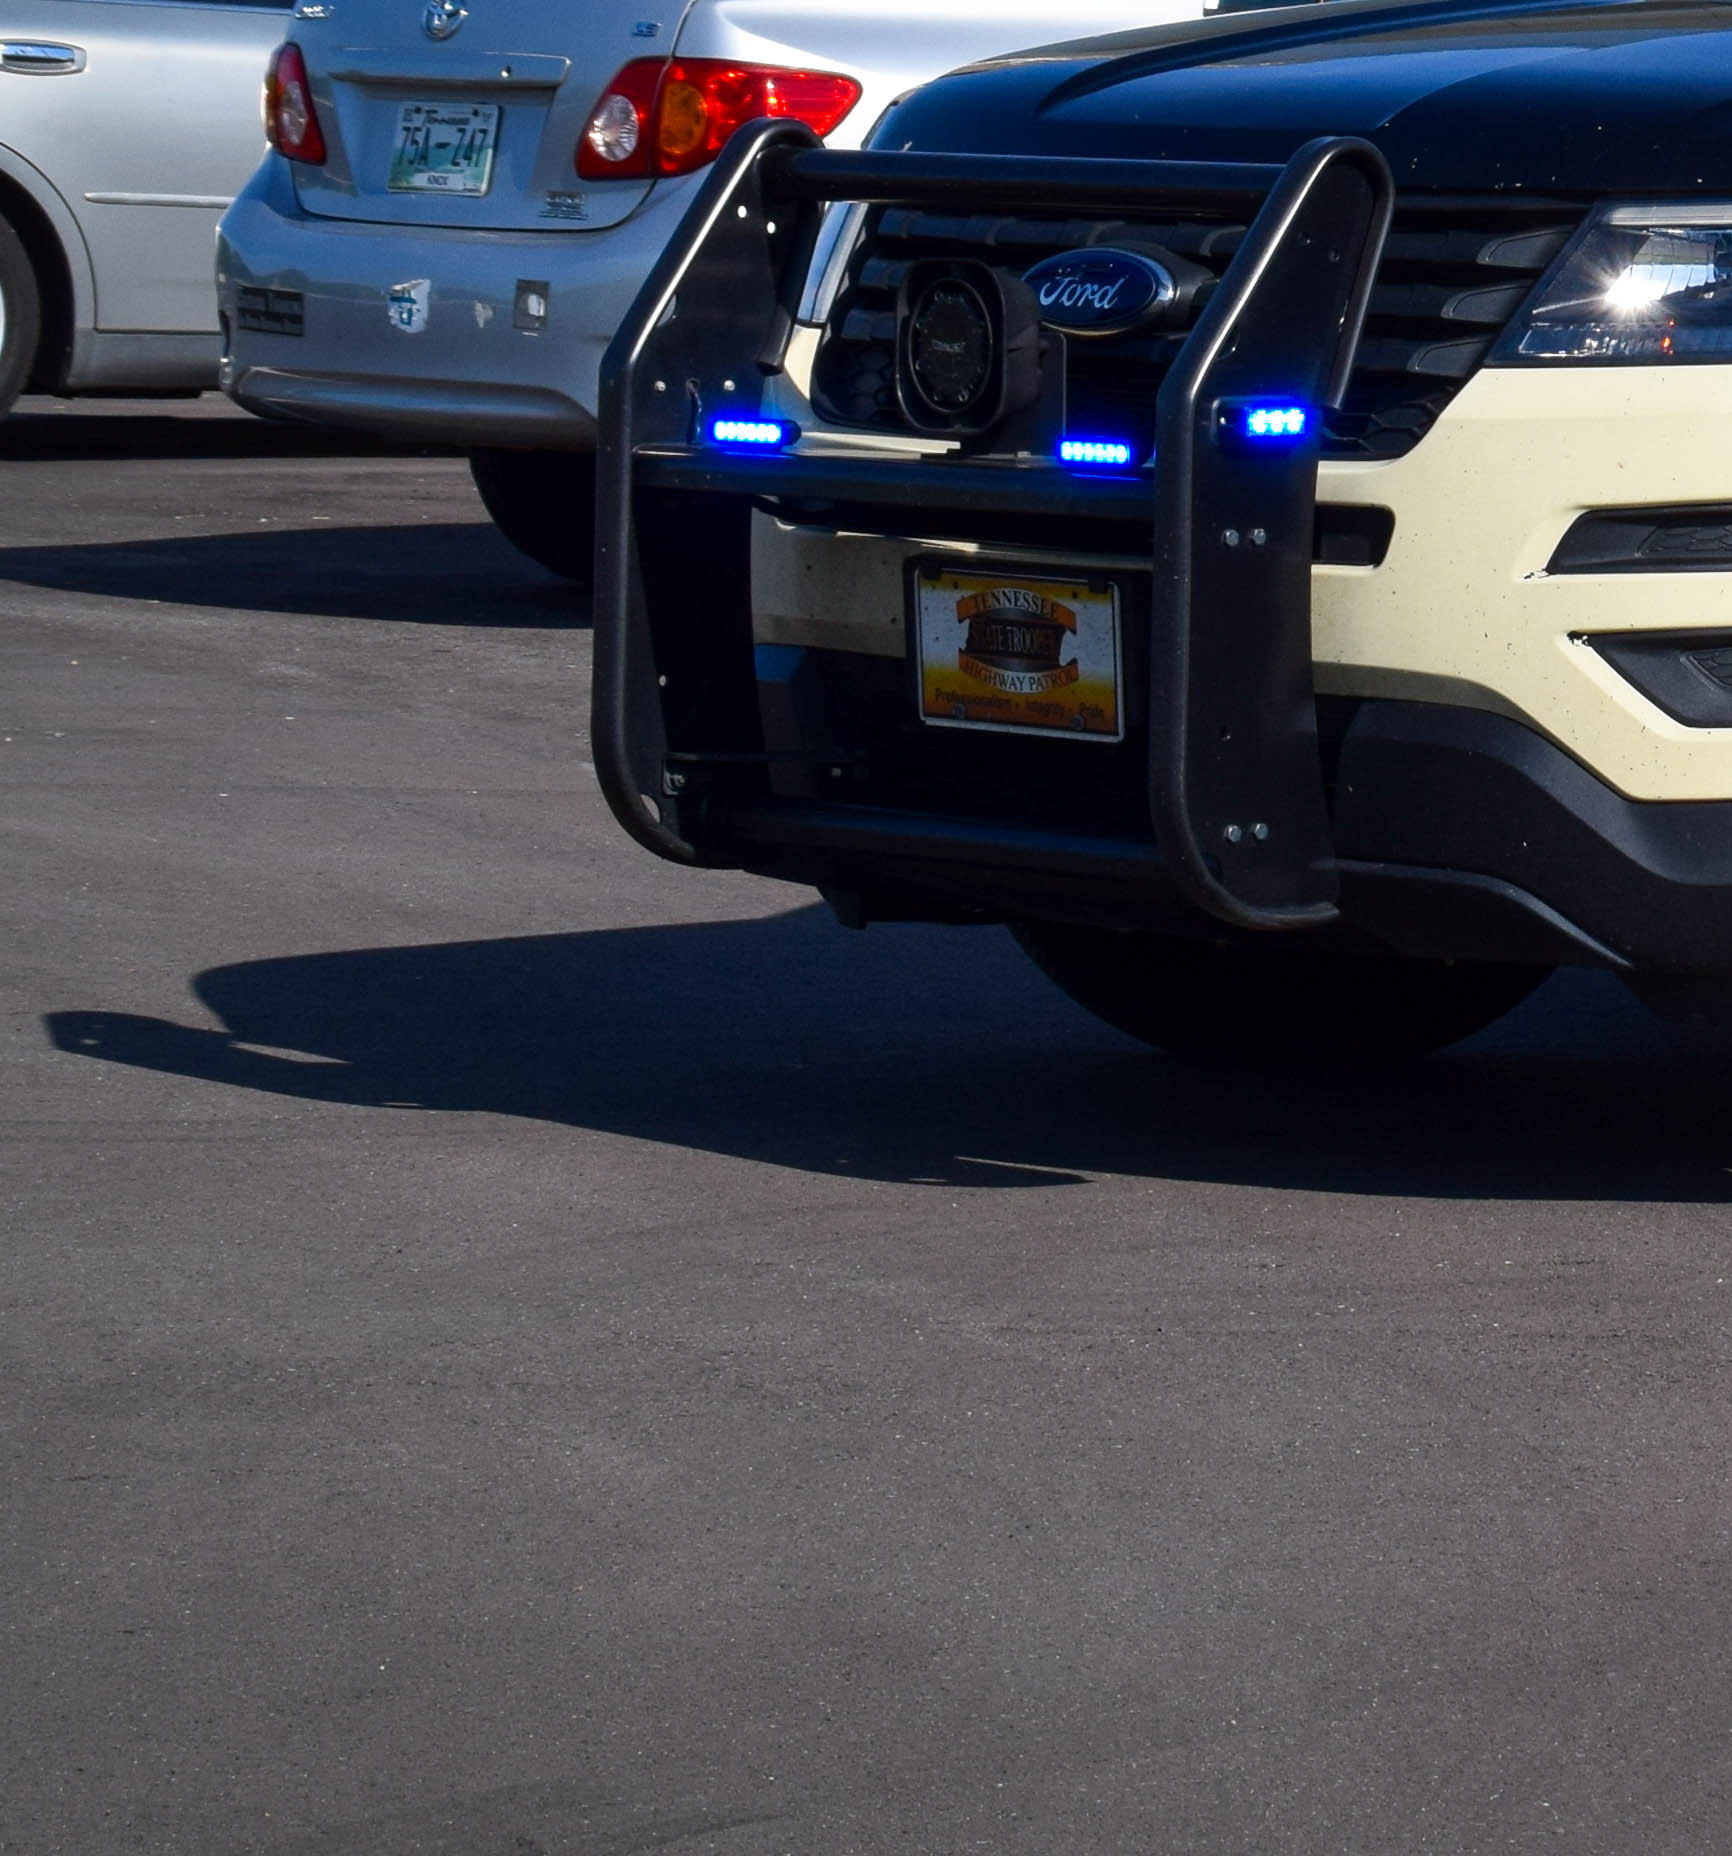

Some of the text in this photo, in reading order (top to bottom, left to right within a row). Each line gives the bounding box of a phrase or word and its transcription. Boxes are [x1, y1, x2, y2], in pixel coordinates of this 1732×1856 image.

[1039, 274, 1129, 310] Ford
[973, 590, 1057, 619] TENNESSEE
[968, 659, 1026, 691] HIGHWAY
